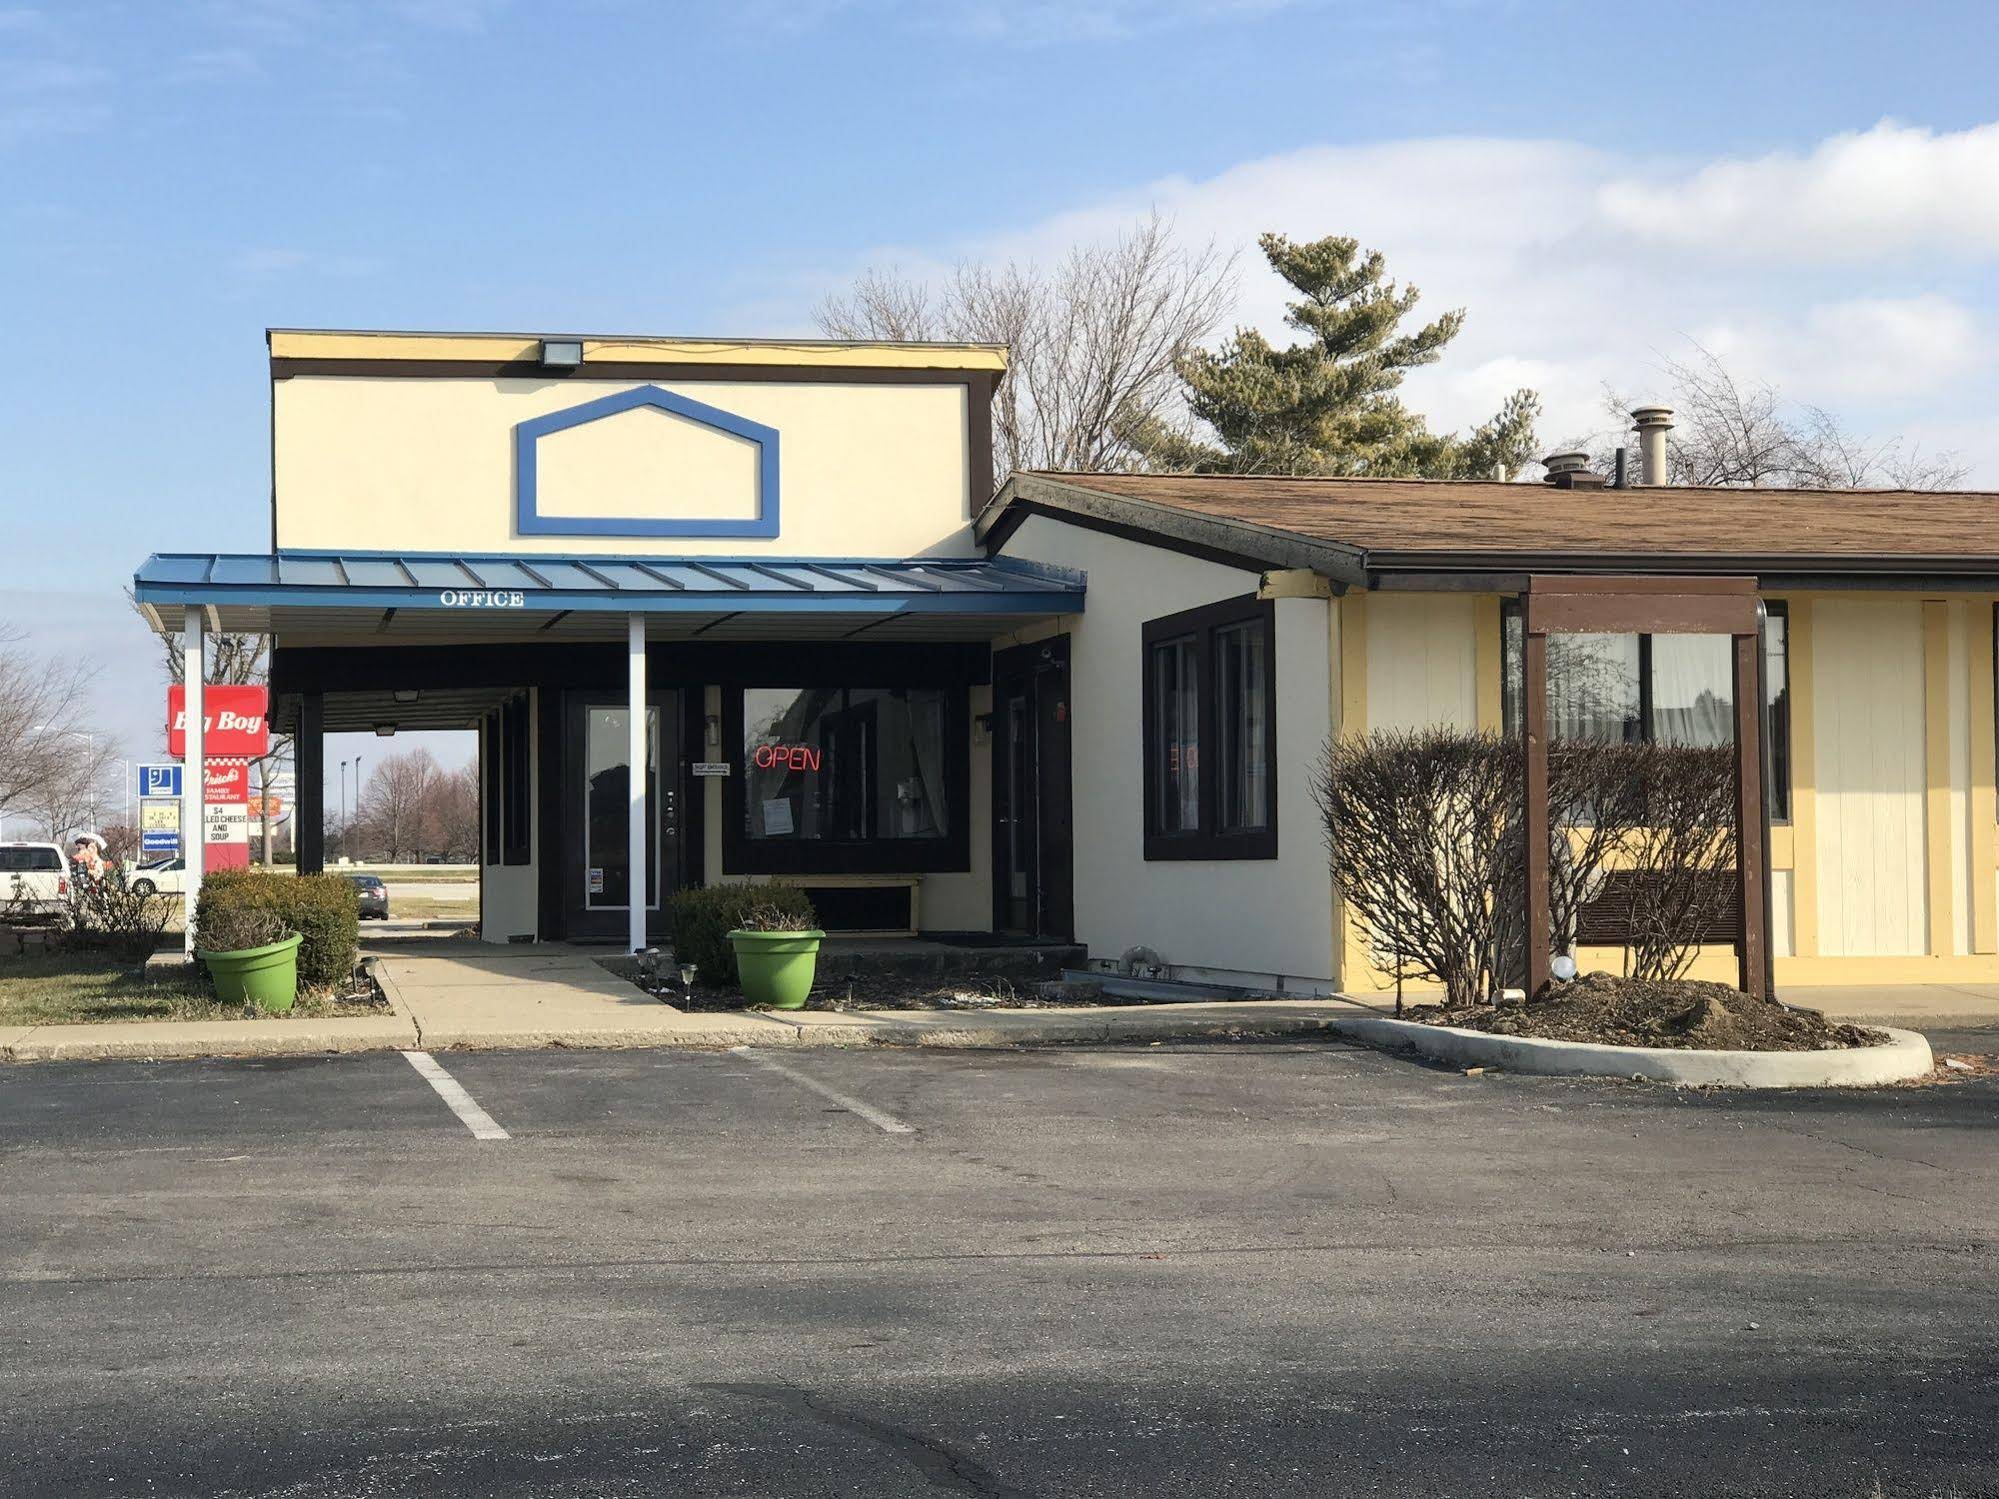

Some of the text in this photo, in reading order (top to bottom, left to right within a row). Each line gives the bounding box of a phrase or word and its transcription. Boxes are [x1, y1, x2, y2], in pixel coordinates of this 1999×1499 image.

[440, 590, 524, 607] OFFICE
[217, 711, 262, 735] Boy
[755, 745, 820, 771] OPEN
[220, 815, 247, 823] CHEESE
[212, 824, 228, 832] AND
[210, 833, 229, 841] SOUP
